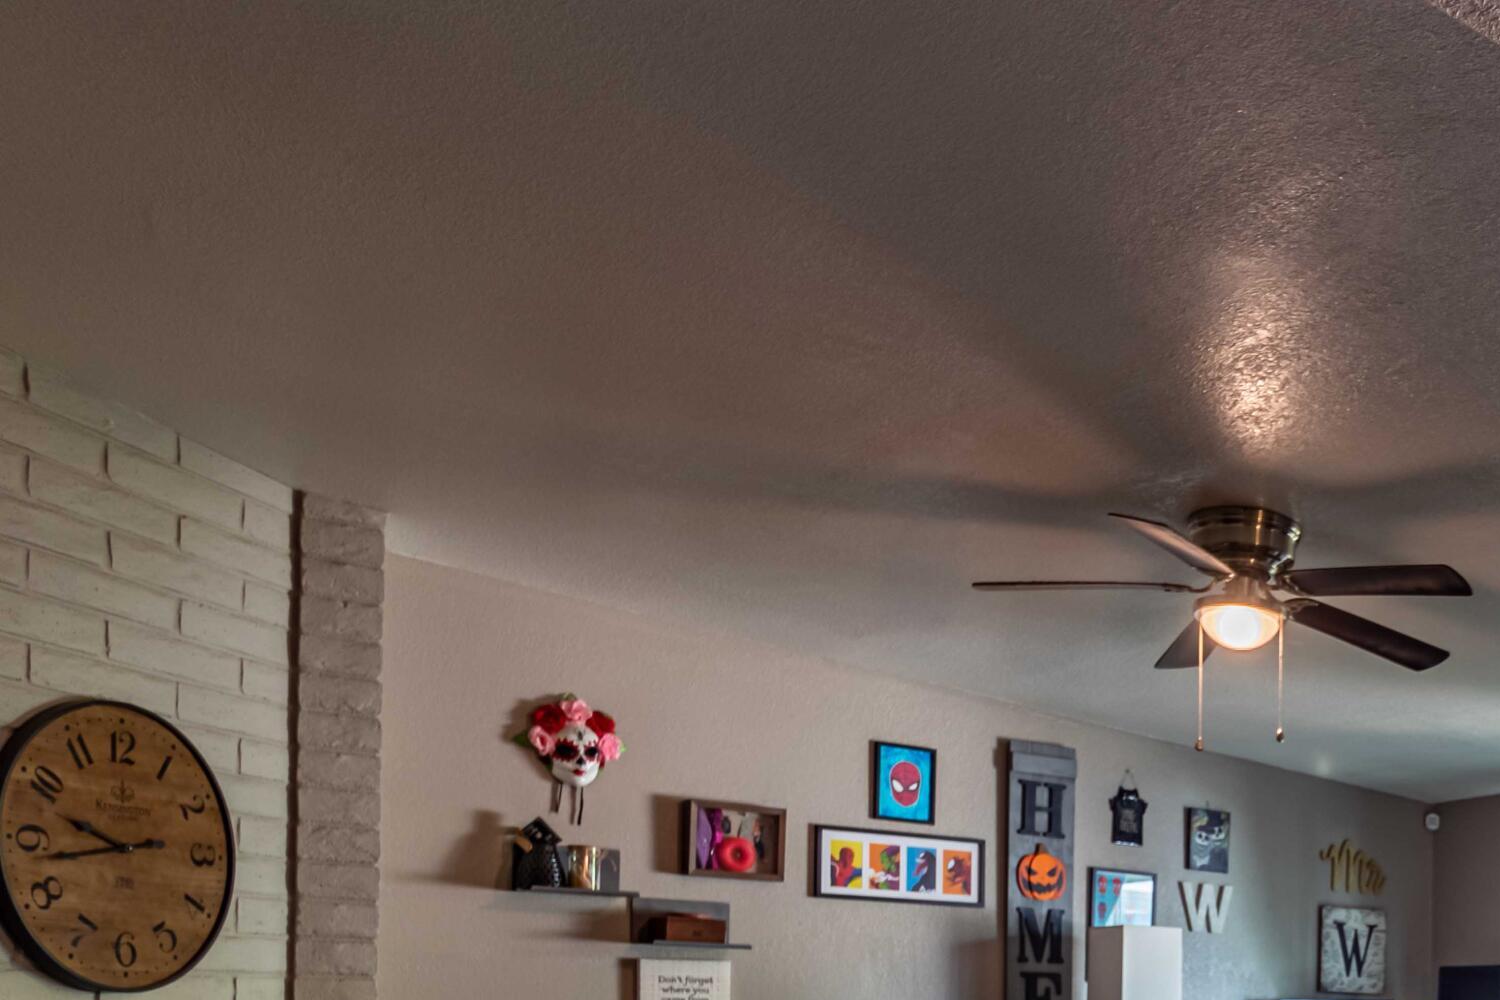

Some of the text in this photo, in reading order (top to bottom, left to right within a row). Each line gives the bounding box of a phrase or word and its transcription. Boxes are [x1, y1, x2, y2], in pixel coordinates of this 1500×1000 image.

[67, 733, 94, 770] 11
[110, 730, 136, 766] 12
[31, 765, 64, 804] 10
[156, 755, 172, 781] 1
[180, 794, 205, 820] 2
[15, 824, 50, 853] 9
[190, 842, 216, 868] 3
[31, 876, 63, 910] 8
[184, 893, 206, 920] 4
[1180, 881, 1233, 933] W
[71, 913, 98, 948] 7
[153, 921, 177, 953] 5
[115, 931, 137, 967] 6
[1333, 920, 1378, 978] W
[662, 986, 710, 995] where you
[684, 975, 713, 986] forget
